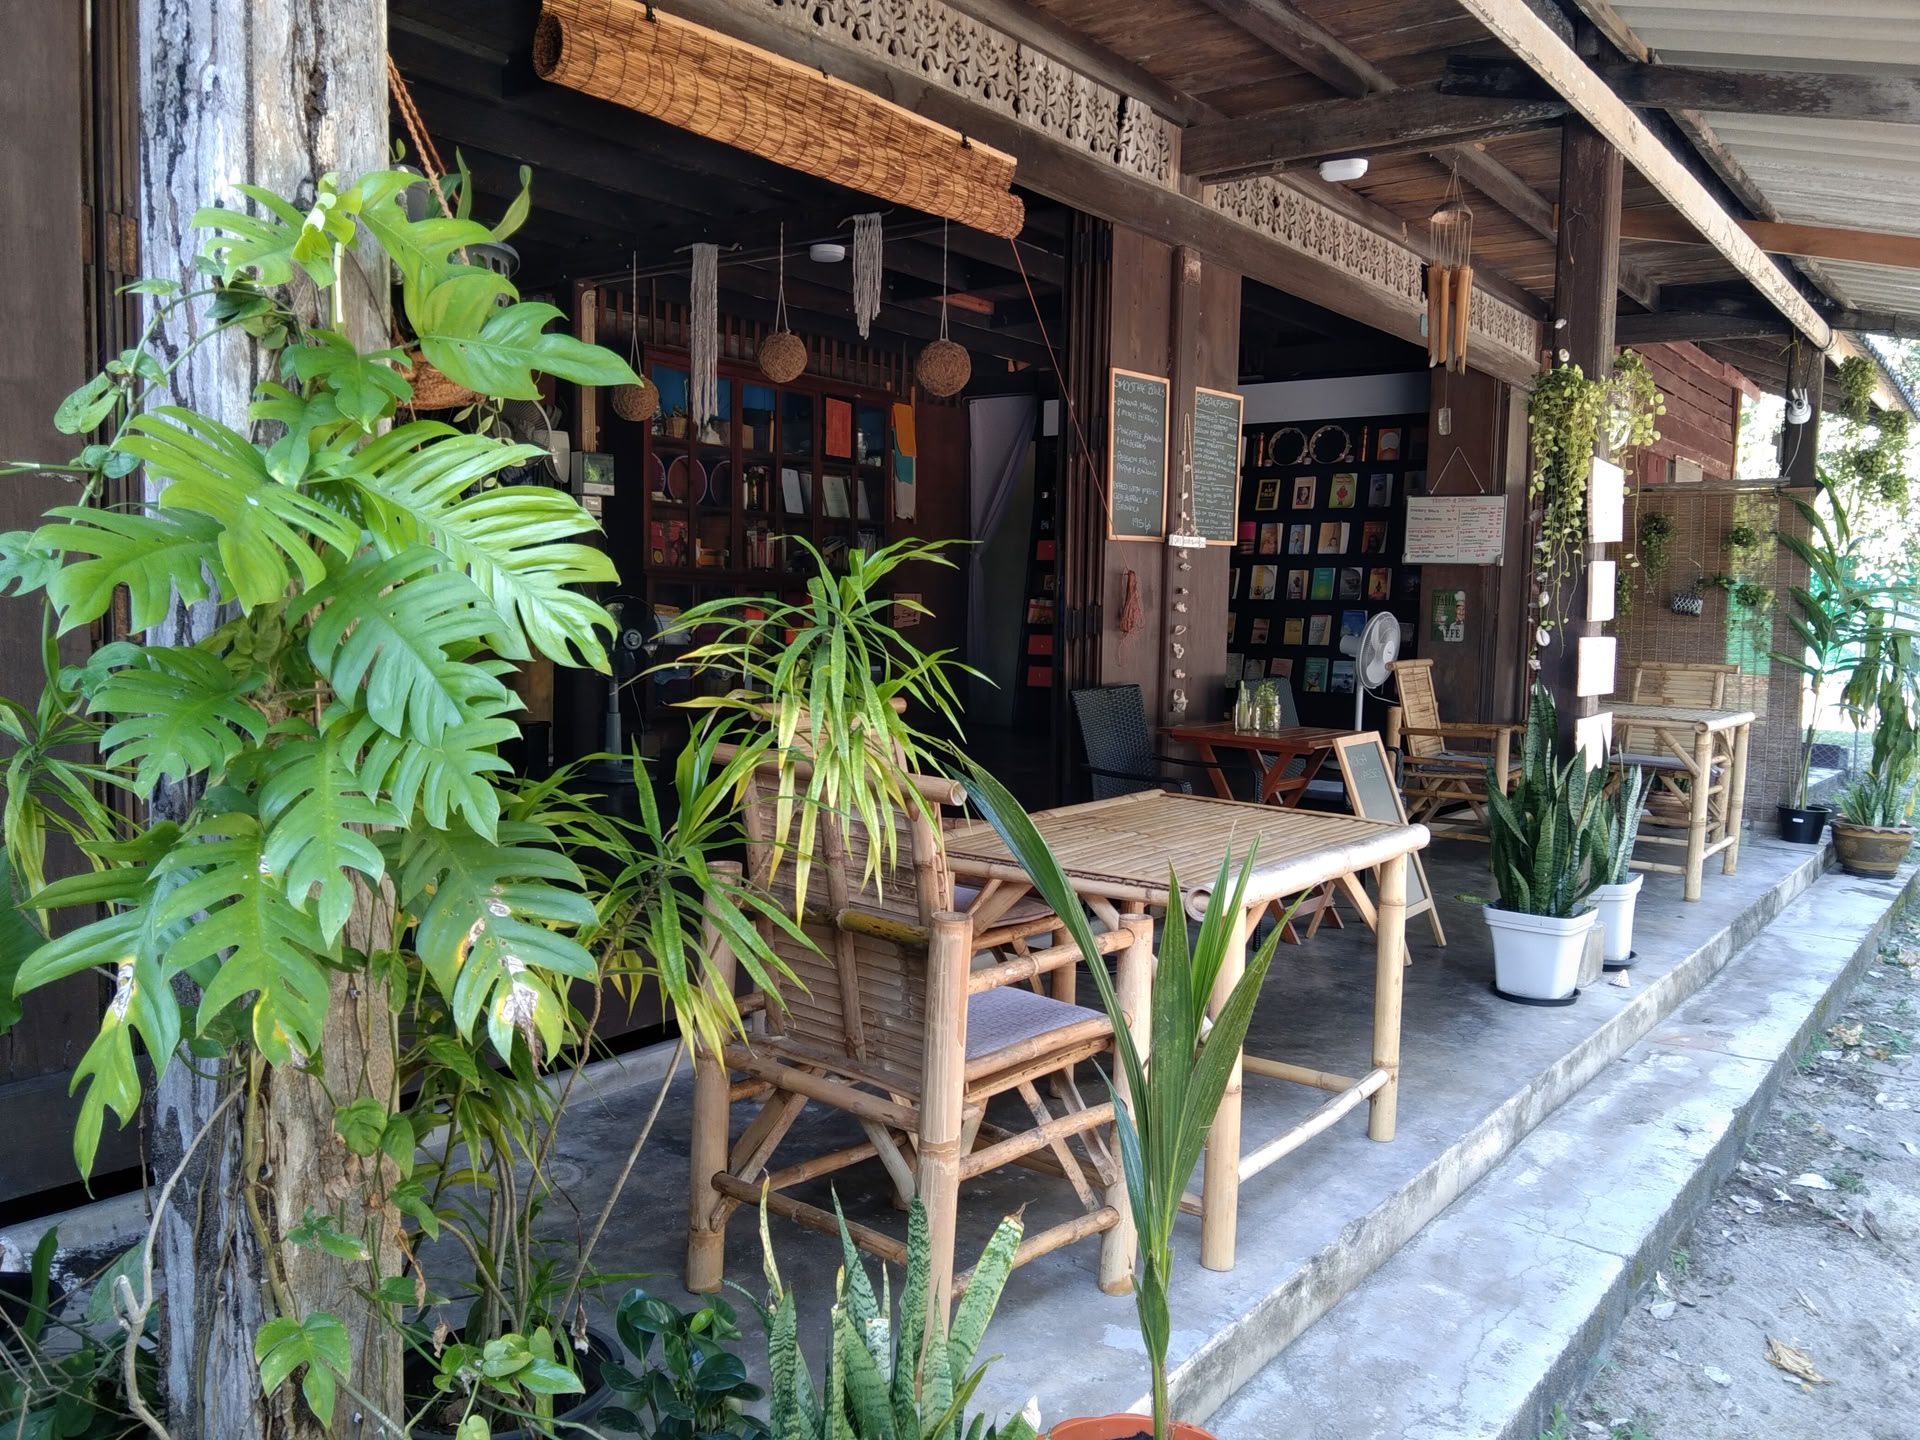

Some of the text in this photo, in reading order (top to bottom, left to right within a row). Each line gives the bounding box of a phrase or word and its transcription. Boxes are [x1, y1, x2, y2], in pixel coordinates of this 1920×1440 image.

[1115, 377, 1146, 395] SMOOTHIE
[1197, 393, 1234, 410] BREAKFAST
[1115, 504, 1140, 514] GRANOLA
